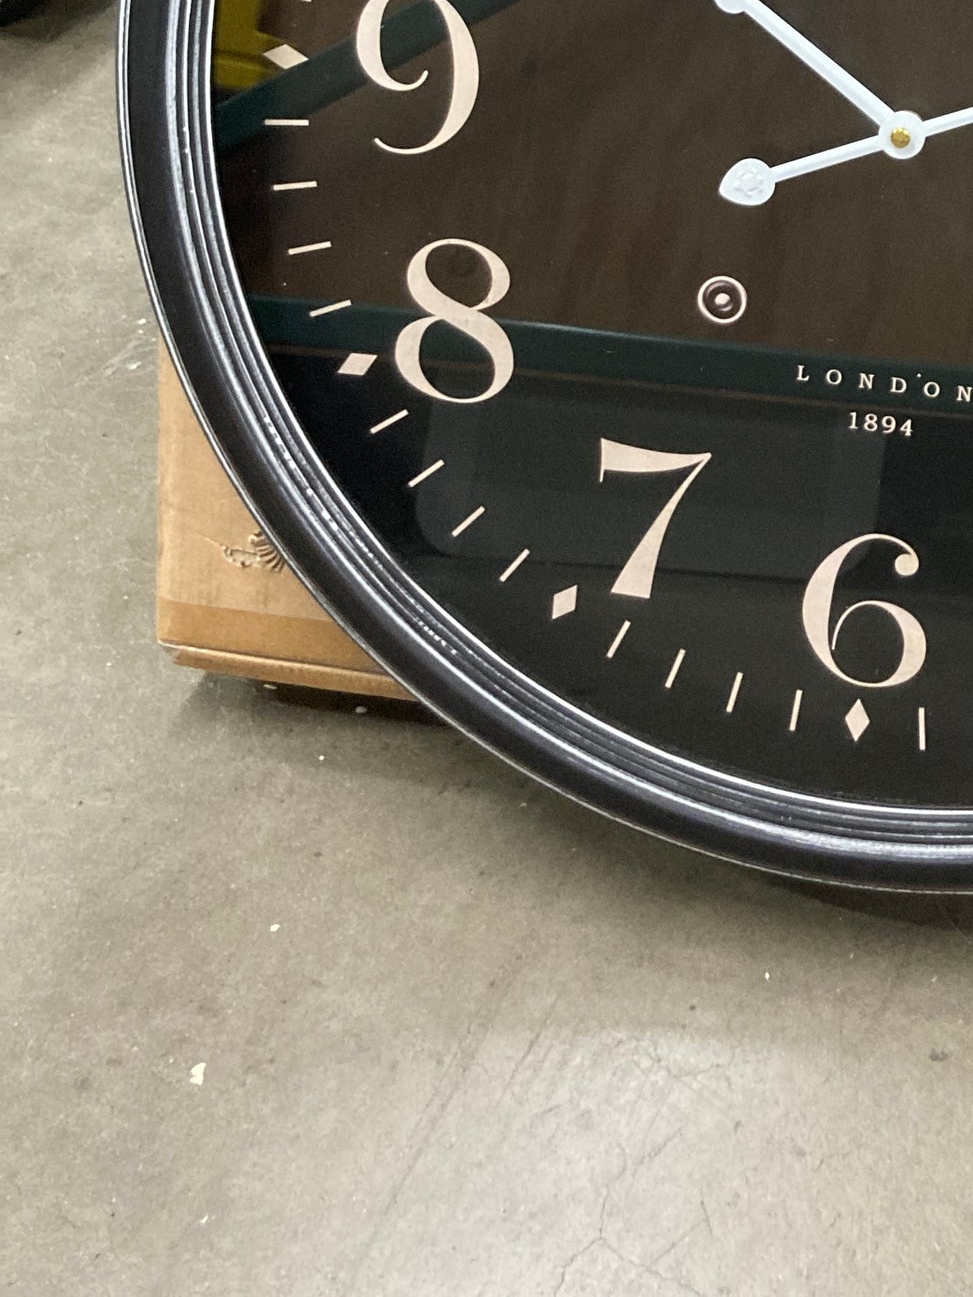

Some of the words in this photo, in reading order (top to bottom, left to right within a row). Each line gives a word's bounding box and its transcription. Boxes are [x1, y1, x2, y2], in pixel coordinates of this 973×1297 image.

[394, 238, 515, 403] 8
[796, 364, 973, 403] LONDON
[848, 411, 914, 437] 1894
[599, 437, 713, 600] 7
[801, 533, 927, 688] 6
